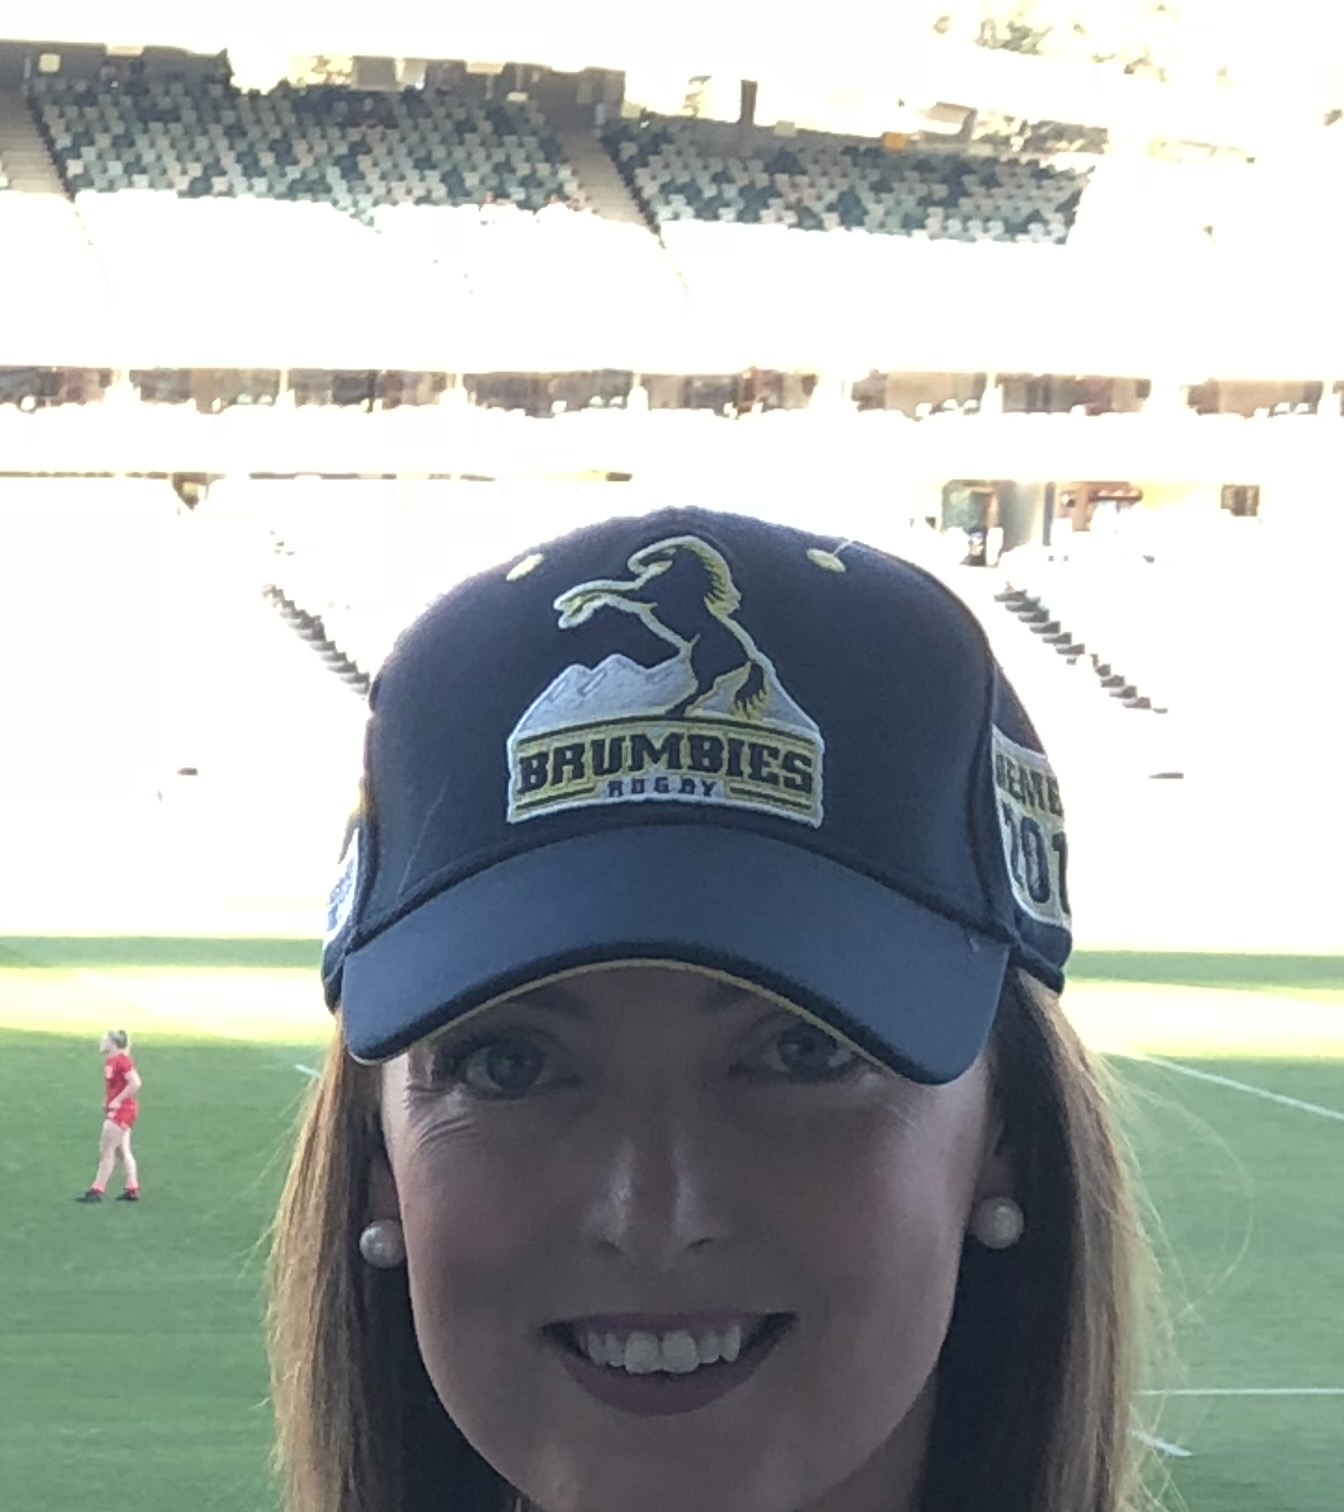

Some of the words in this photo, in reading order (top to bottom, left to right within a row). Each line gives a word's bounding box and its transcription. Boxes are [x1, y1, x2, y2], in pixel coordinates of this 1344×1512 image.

[518, 733, 813, 794] BRUMBIES
[608, 777, 718, 797] RUGBY
[1001, 800, 1071, 915] 201
